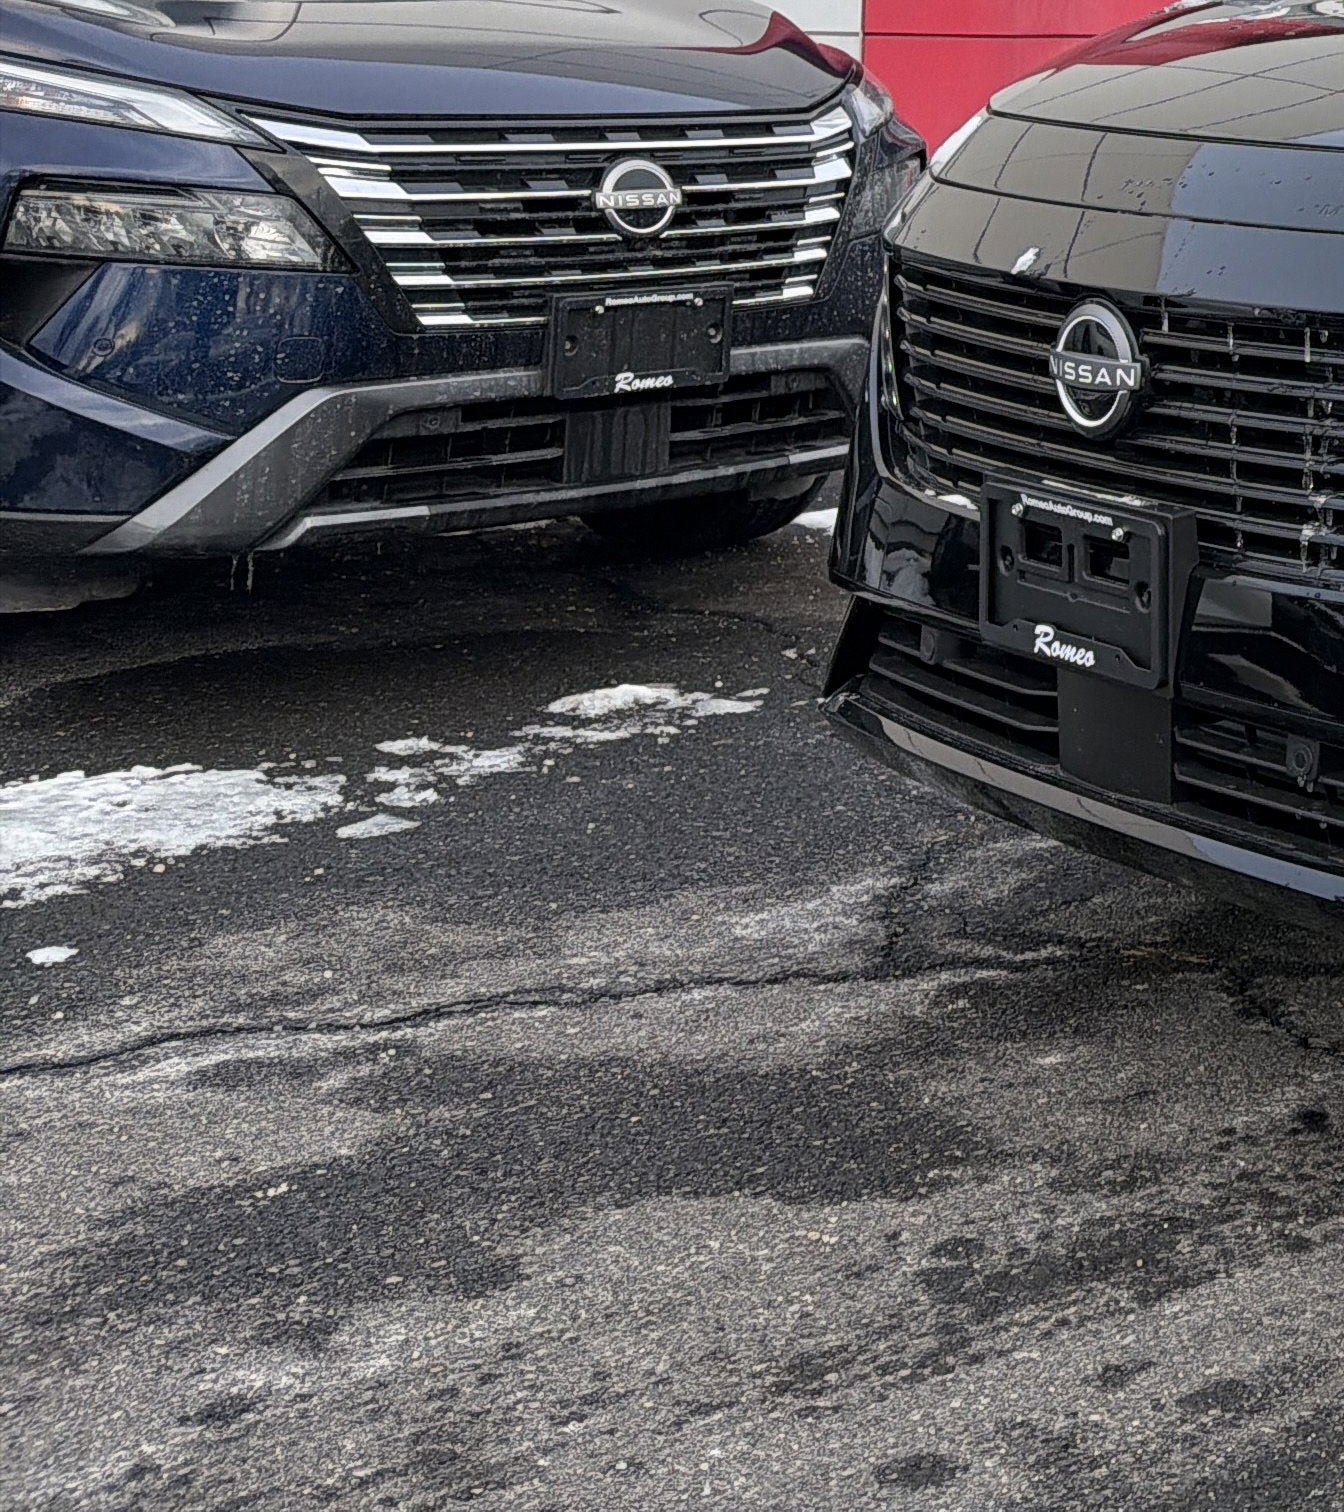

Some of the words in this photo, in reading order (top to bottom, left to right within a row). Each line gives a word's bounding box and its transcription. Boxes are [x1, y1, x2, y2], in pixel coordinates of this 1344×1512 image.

[599, 192, 682, 207] NISSAN
[605, 293, 694, 306] RomeoAutoGroup.com
[614, 371, 674, 393] Romeo
[1050, 355, 1136, 387] NISSAN
[1020, 493, 1114, 526] RomeoAutoGroup.com
[1034, 624, 1095, 667] Romeo
